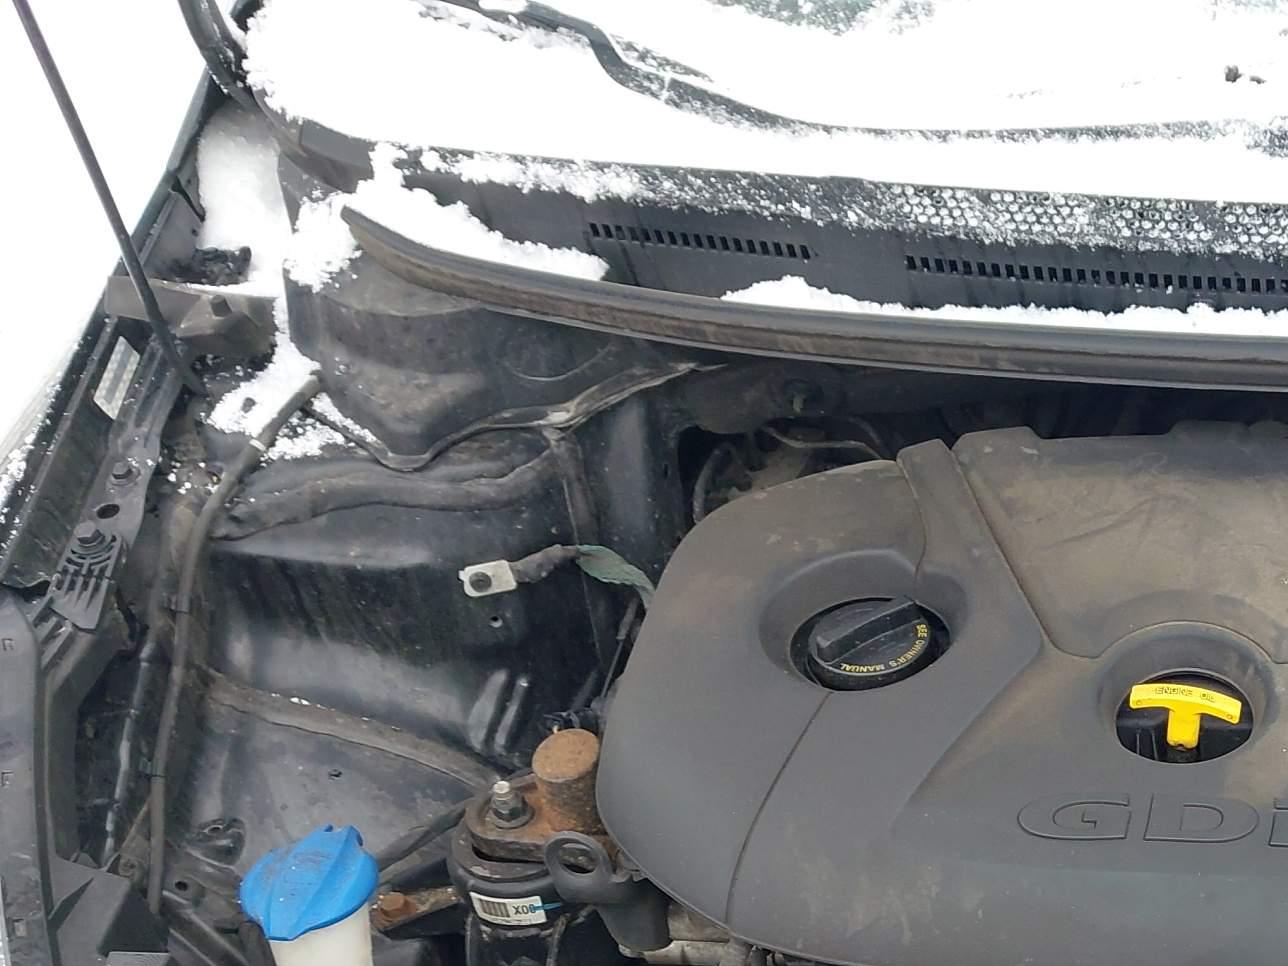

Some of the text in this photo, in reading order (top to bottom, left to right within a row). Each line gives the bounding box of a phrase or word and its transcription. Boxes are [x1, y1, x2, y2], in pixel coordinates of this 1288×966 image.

[840, 624, 928, 672] SEE OWNER'S MANUAL
[1155, 687, 1193, 697] ENGINE
